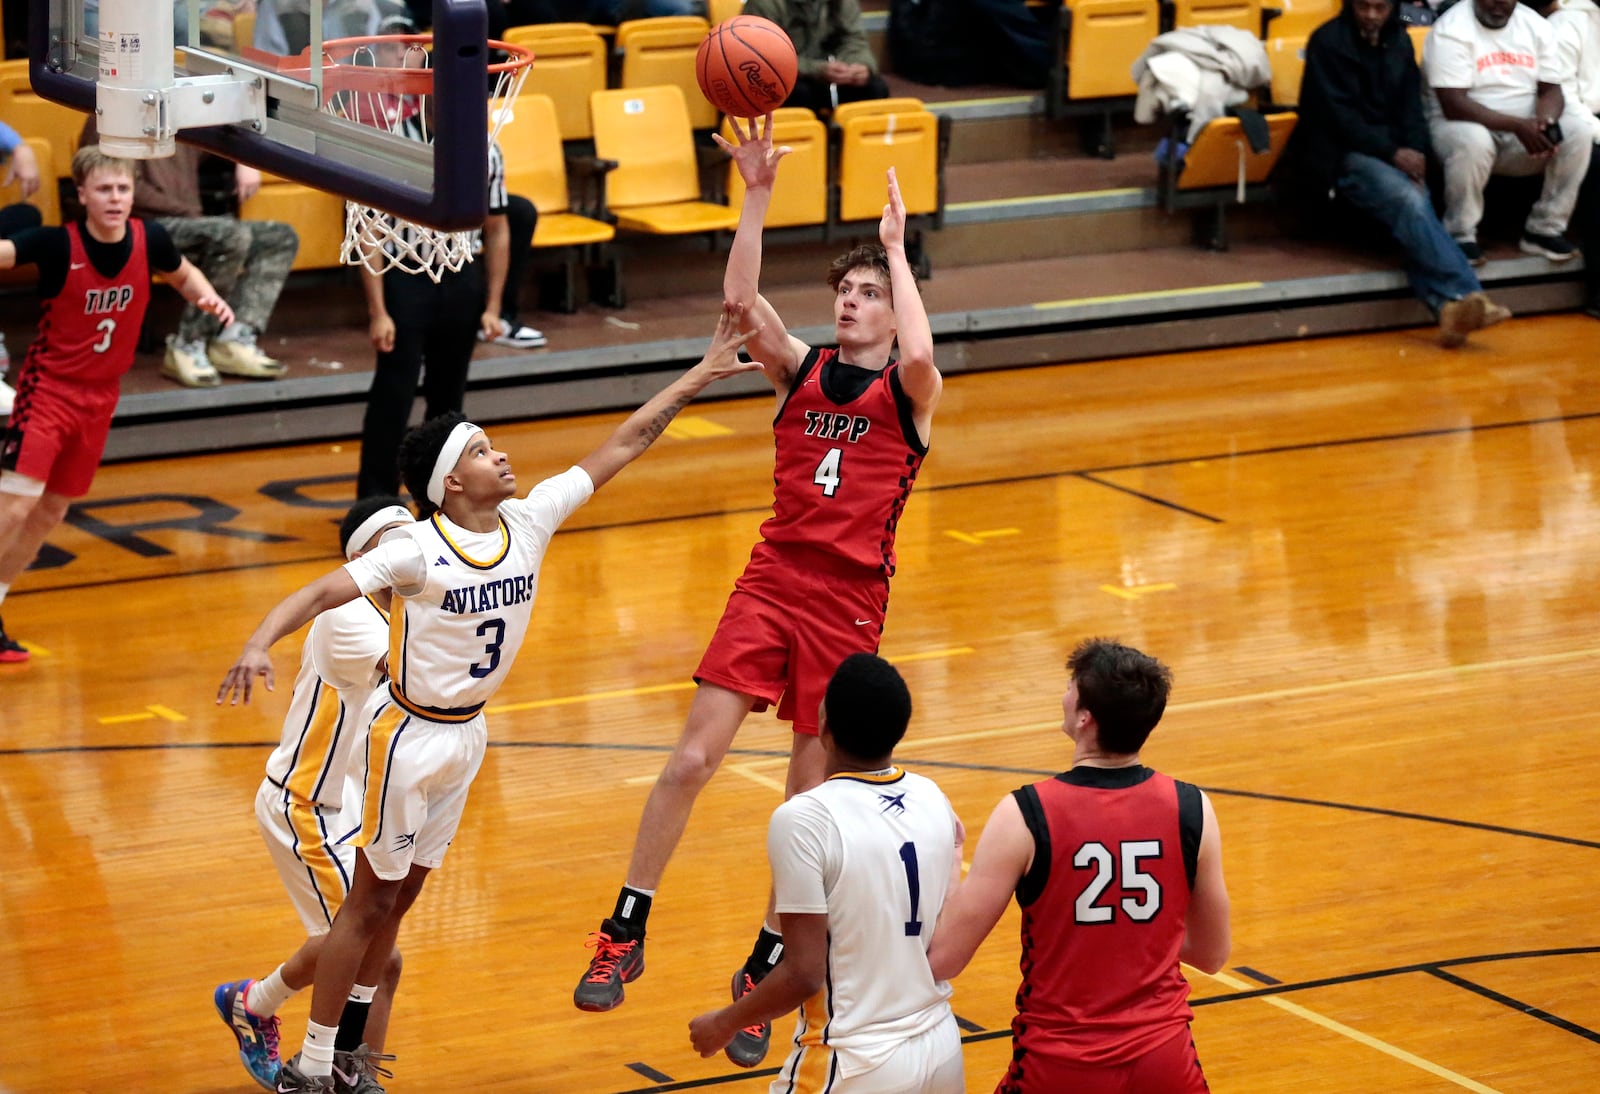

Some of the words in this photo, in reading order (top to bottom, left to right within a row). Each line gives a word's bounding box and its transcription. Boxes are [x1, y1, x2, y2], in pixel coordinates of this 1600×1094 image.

[84, 284, 134, 315] TIPP
[93, 317, 116, 353] 3
[804, 409, 871, 443] TIPP
[813, 447, 843, 498] 4
[440, 573, 534, 614] AVIATORS
[469, 618, 506, 678] 3
[899, 842, 921, 936] 1
[1073, 840, 1162, 925] 25
